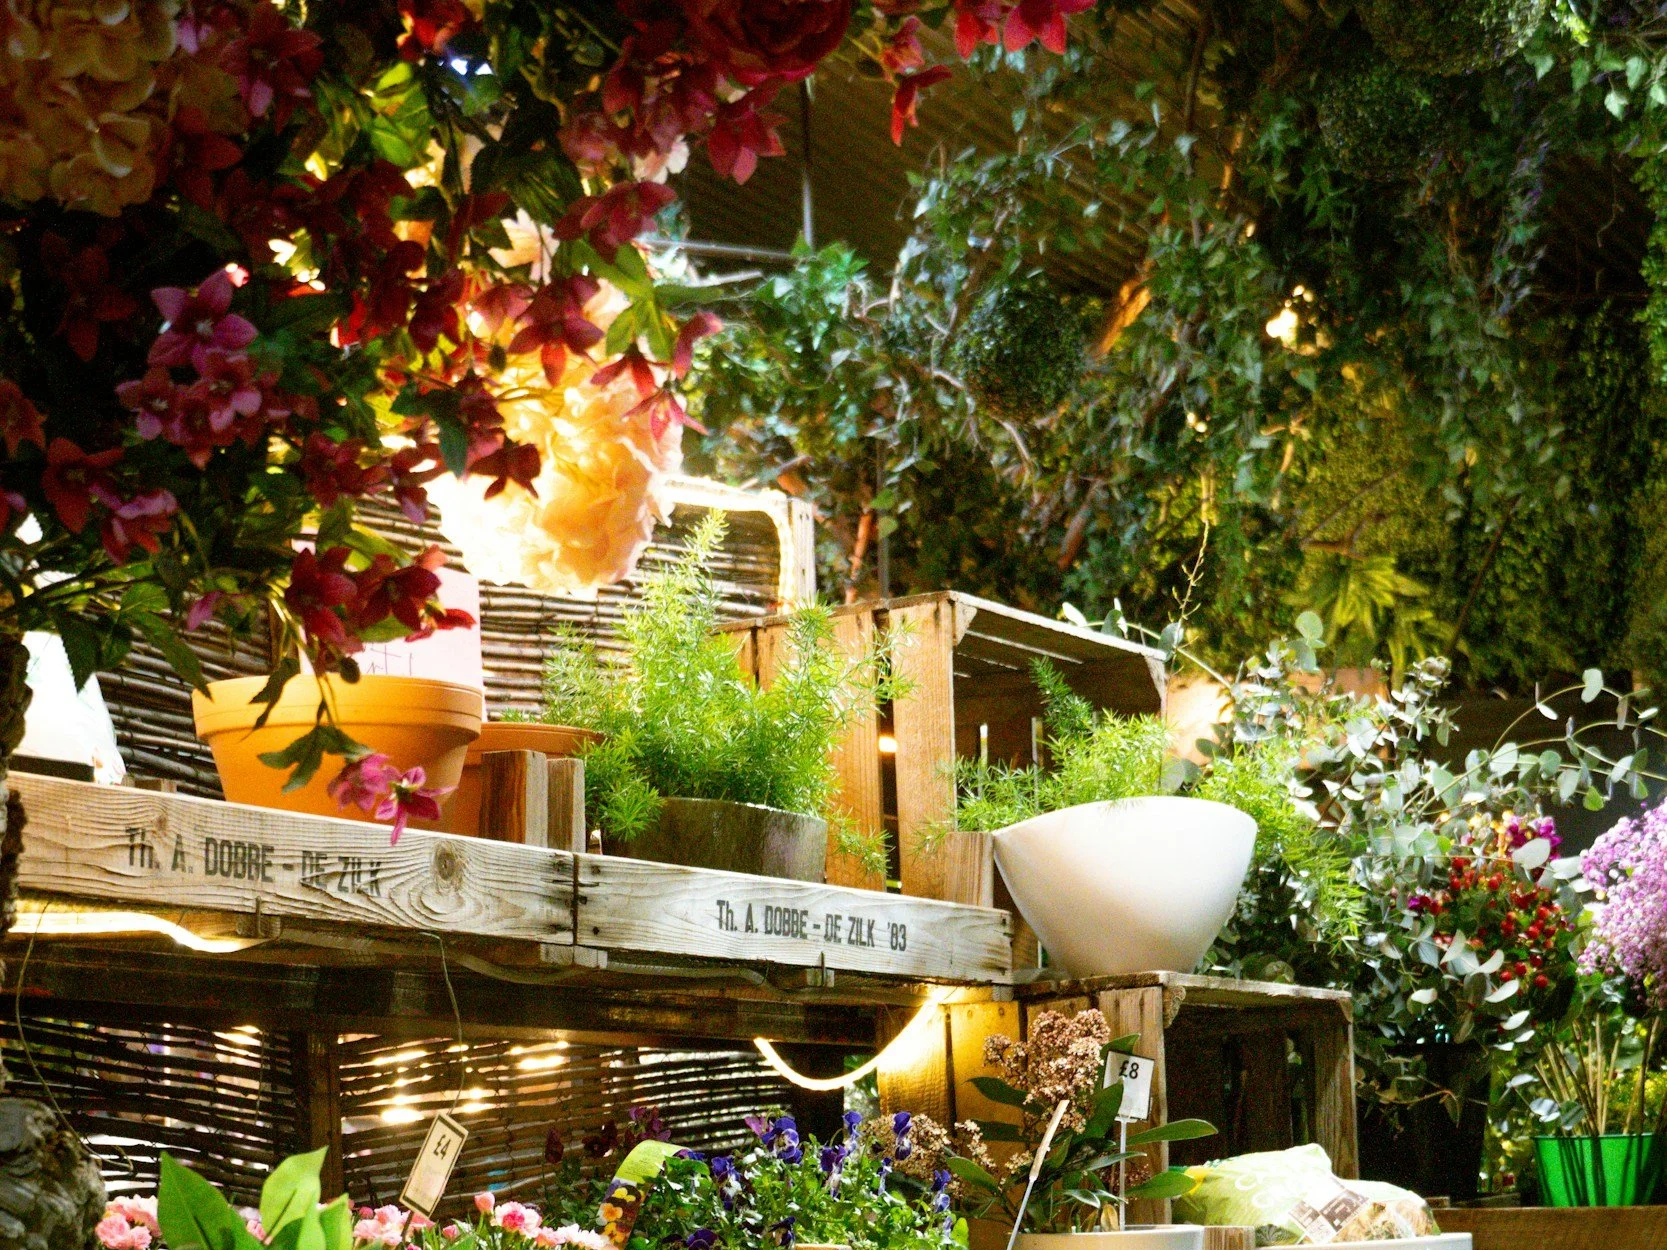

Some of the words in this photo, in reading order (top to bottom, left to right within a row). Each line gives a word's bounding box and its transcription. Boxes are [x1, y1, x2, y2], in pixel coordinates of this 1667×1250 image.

[204, 837, 275, 883] DOBBE
[301, 850, 328, 887] DE
[337, 856, 382, 898] ZILK
[716, 900, 738, 932] Th.
[745, 903, 759, 933] A.
[764, 905, 809, 939] DOBBE
[824, 914, 843, 943] DE
[847, 916, 876, 948] ZILK
[887, 921, 907, 951] '83
[1119, 1060, 1139, 1080] £8
[433, 1134, 452, 1160] £4
